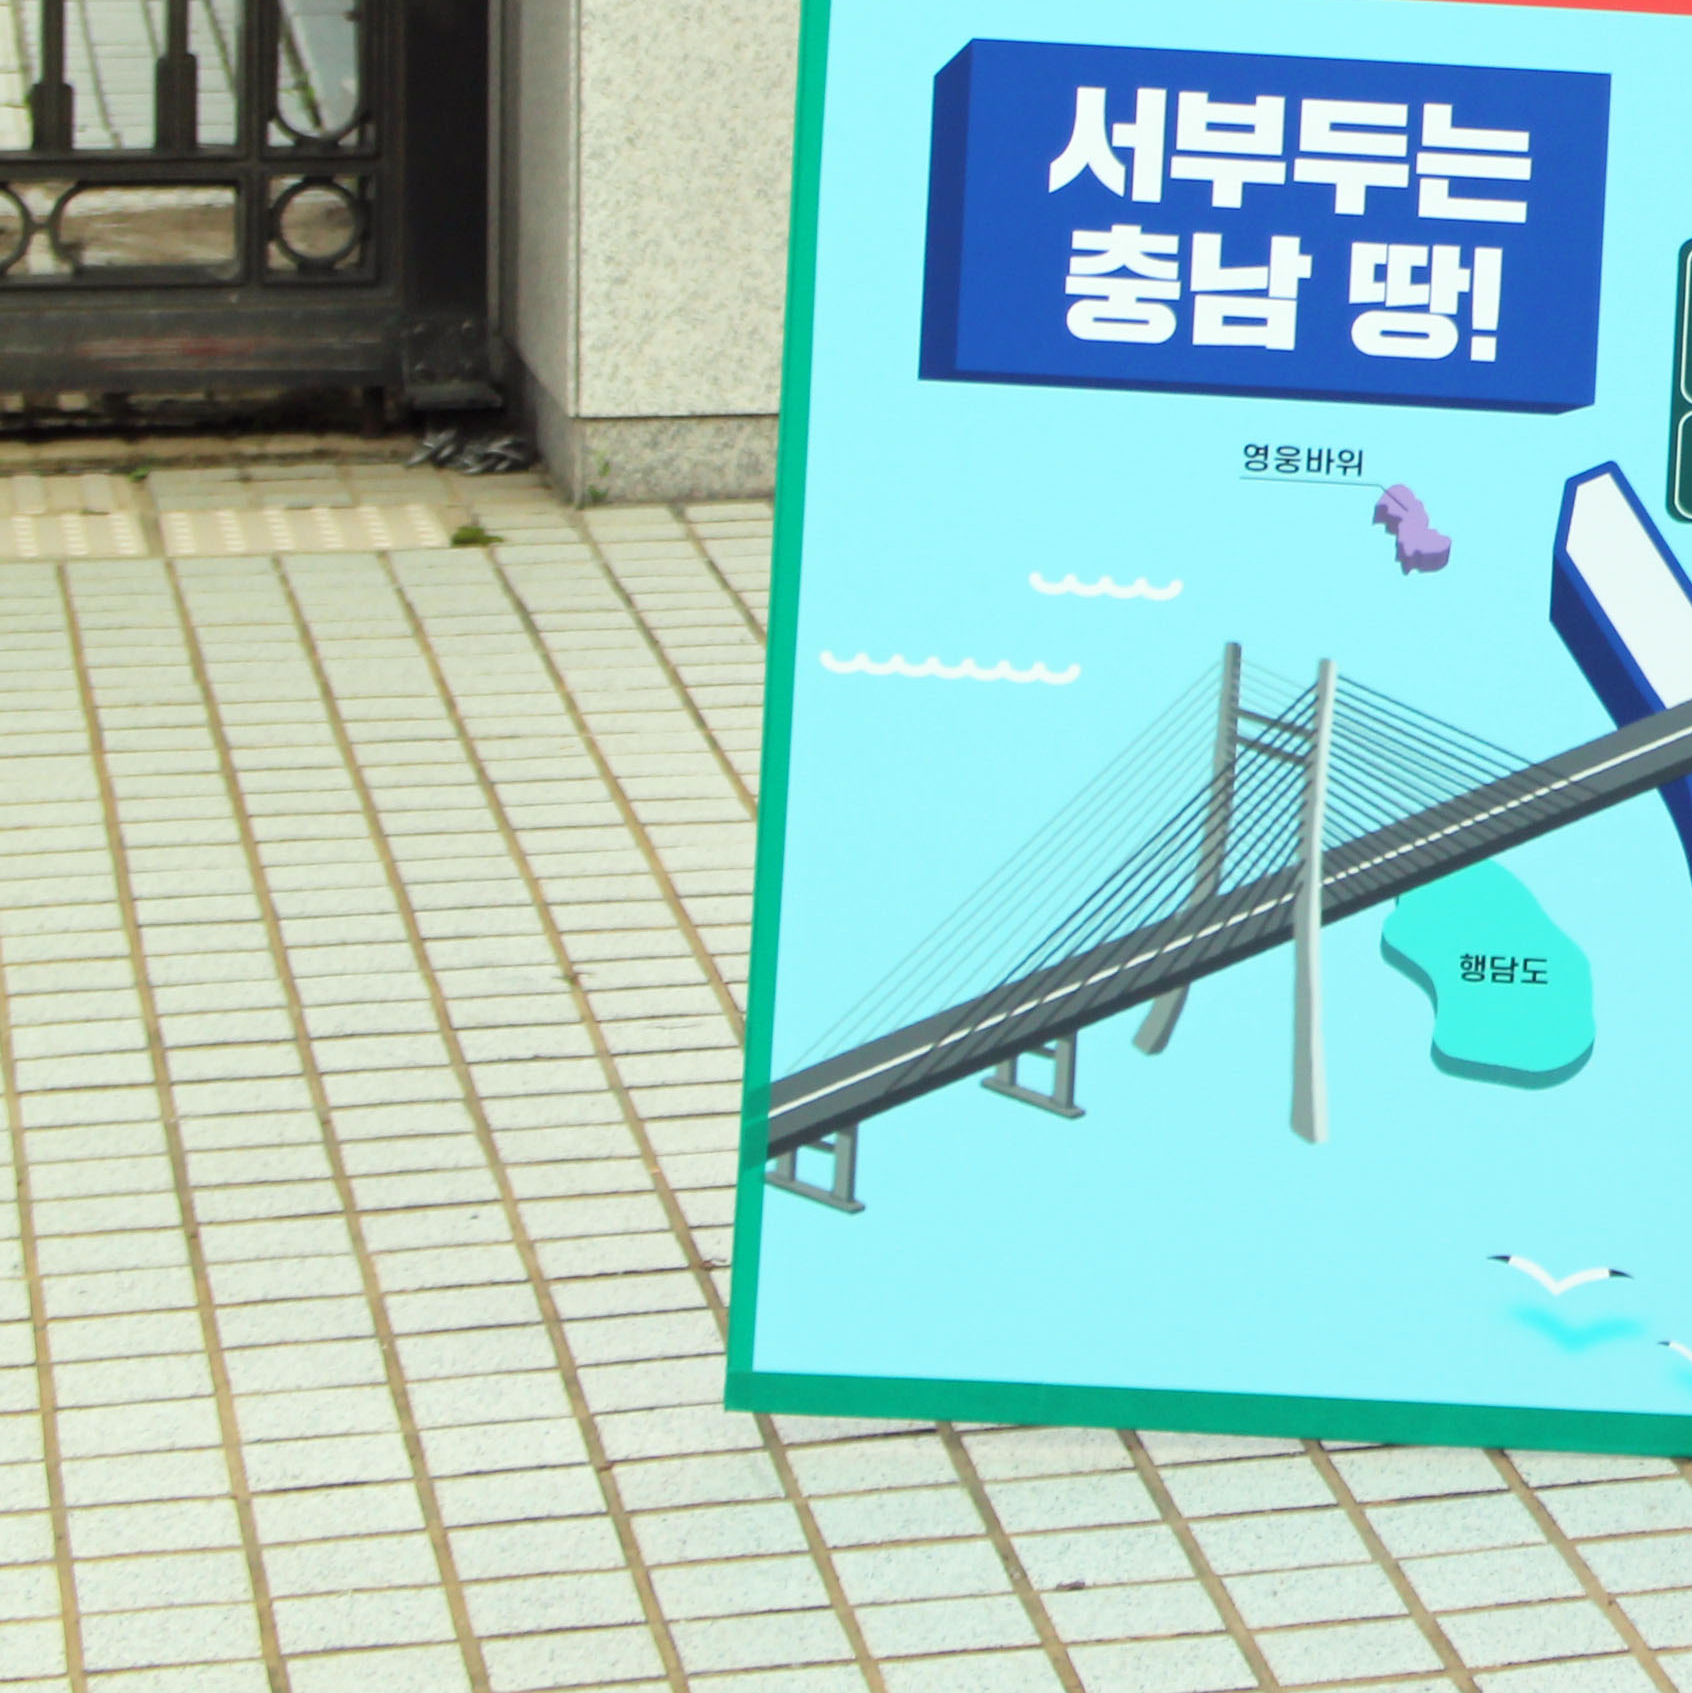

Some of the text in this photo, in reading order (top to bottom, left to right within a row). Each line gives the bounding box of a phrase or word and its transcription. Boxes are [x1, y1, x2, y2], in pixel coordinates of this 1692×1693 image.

[1048, 85, 1532, 223] 서부두는
[1064, 224, 1503, 363] 충남 땅!
[1242, 442, 1365, 478] 영웅바위
[1460, 953, 1549, 985] 행담도
